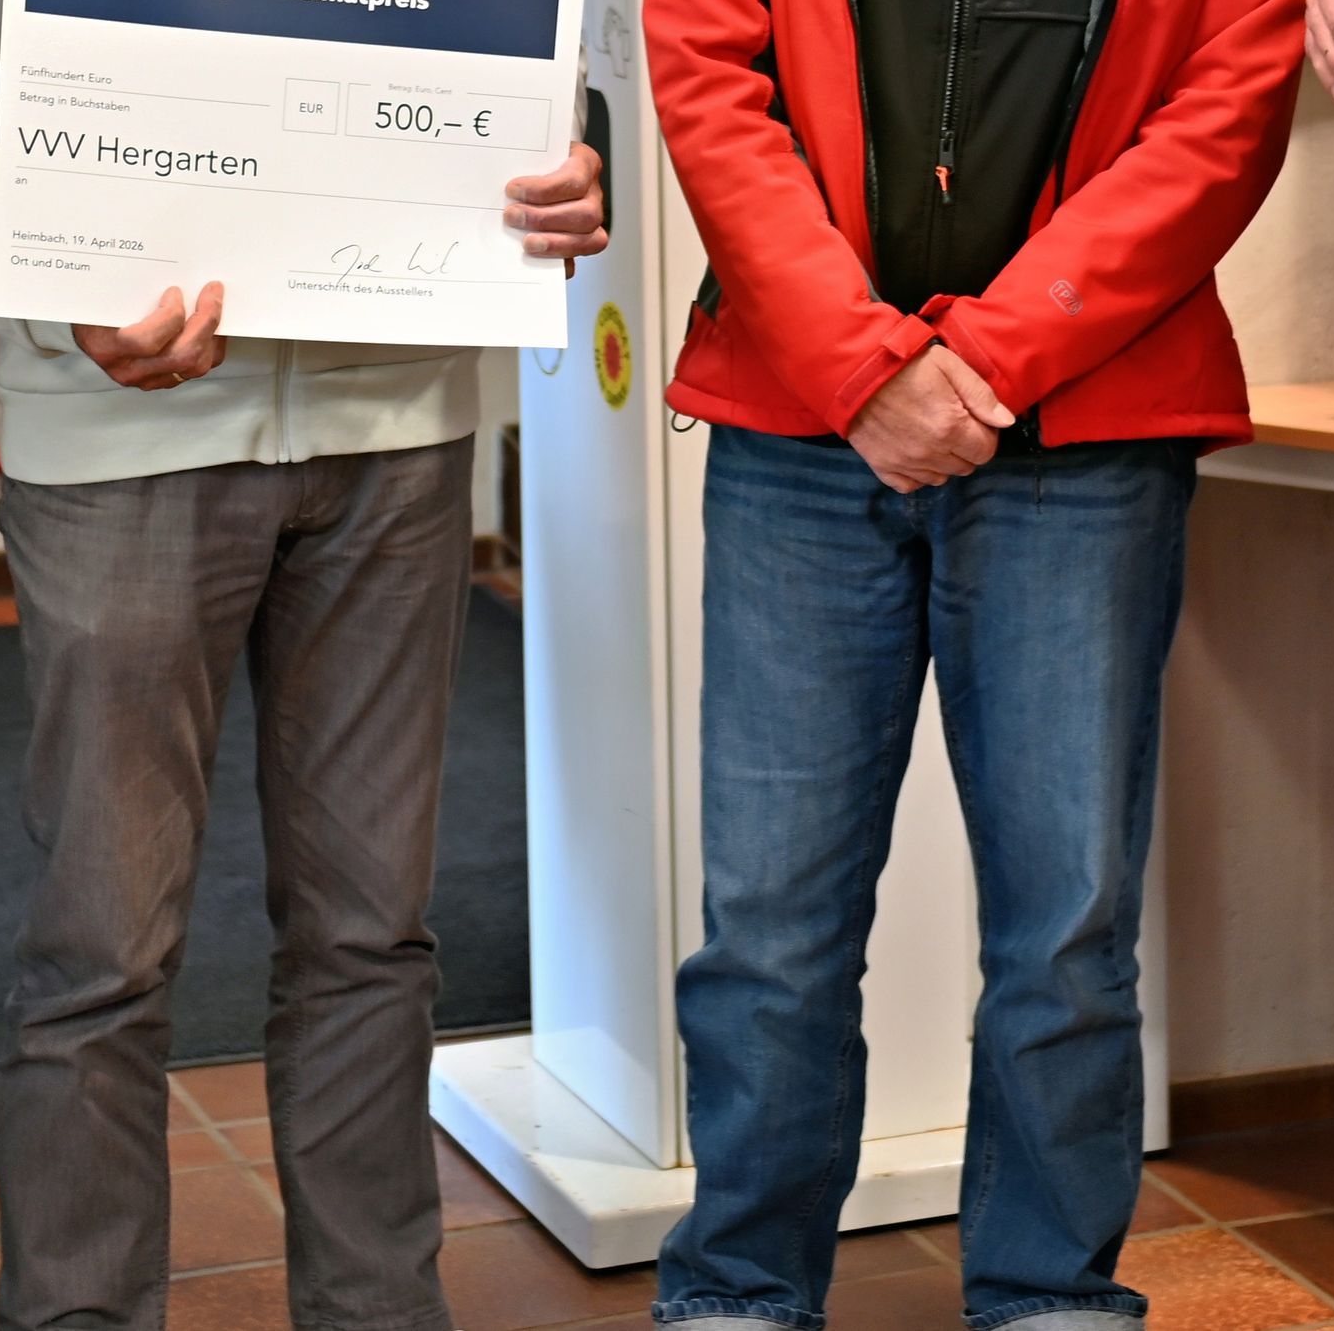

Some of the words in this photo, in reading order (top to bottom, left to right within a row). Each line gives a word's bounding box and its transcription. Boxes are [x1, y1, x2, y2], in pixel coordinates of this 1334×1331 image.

[21, 65, 85, 81] Fünfhundert
[88, 72, 113, 85] Euro
[19, 91, 55, 107] Betrag
[58, 95, 67, 105] in
[70, 96, 130, 111] Buchstaben
[299, 102, 324, 114] EUR
[473, 110, 492, 137] €
[18, 126, 86, 159] VVV
[98, 135, 258, 177] Hergarten
[14, 176, 28, 185] an
[12, 230, 68, 245] Heimbach,
[73, 234, 88, 246] 19.
[90, 236, 116, 250] April
[118, 239, 144, 251] 2026
[10, 255, 28, 266] Ort
[32, 259, 52, 268] und
[55, 258, 91, 272] Datum
[288, 279, 350, 293] Unterschrift
[354, 283, 373, 294] des
[376, 284, 434, 297] Ausstellers
